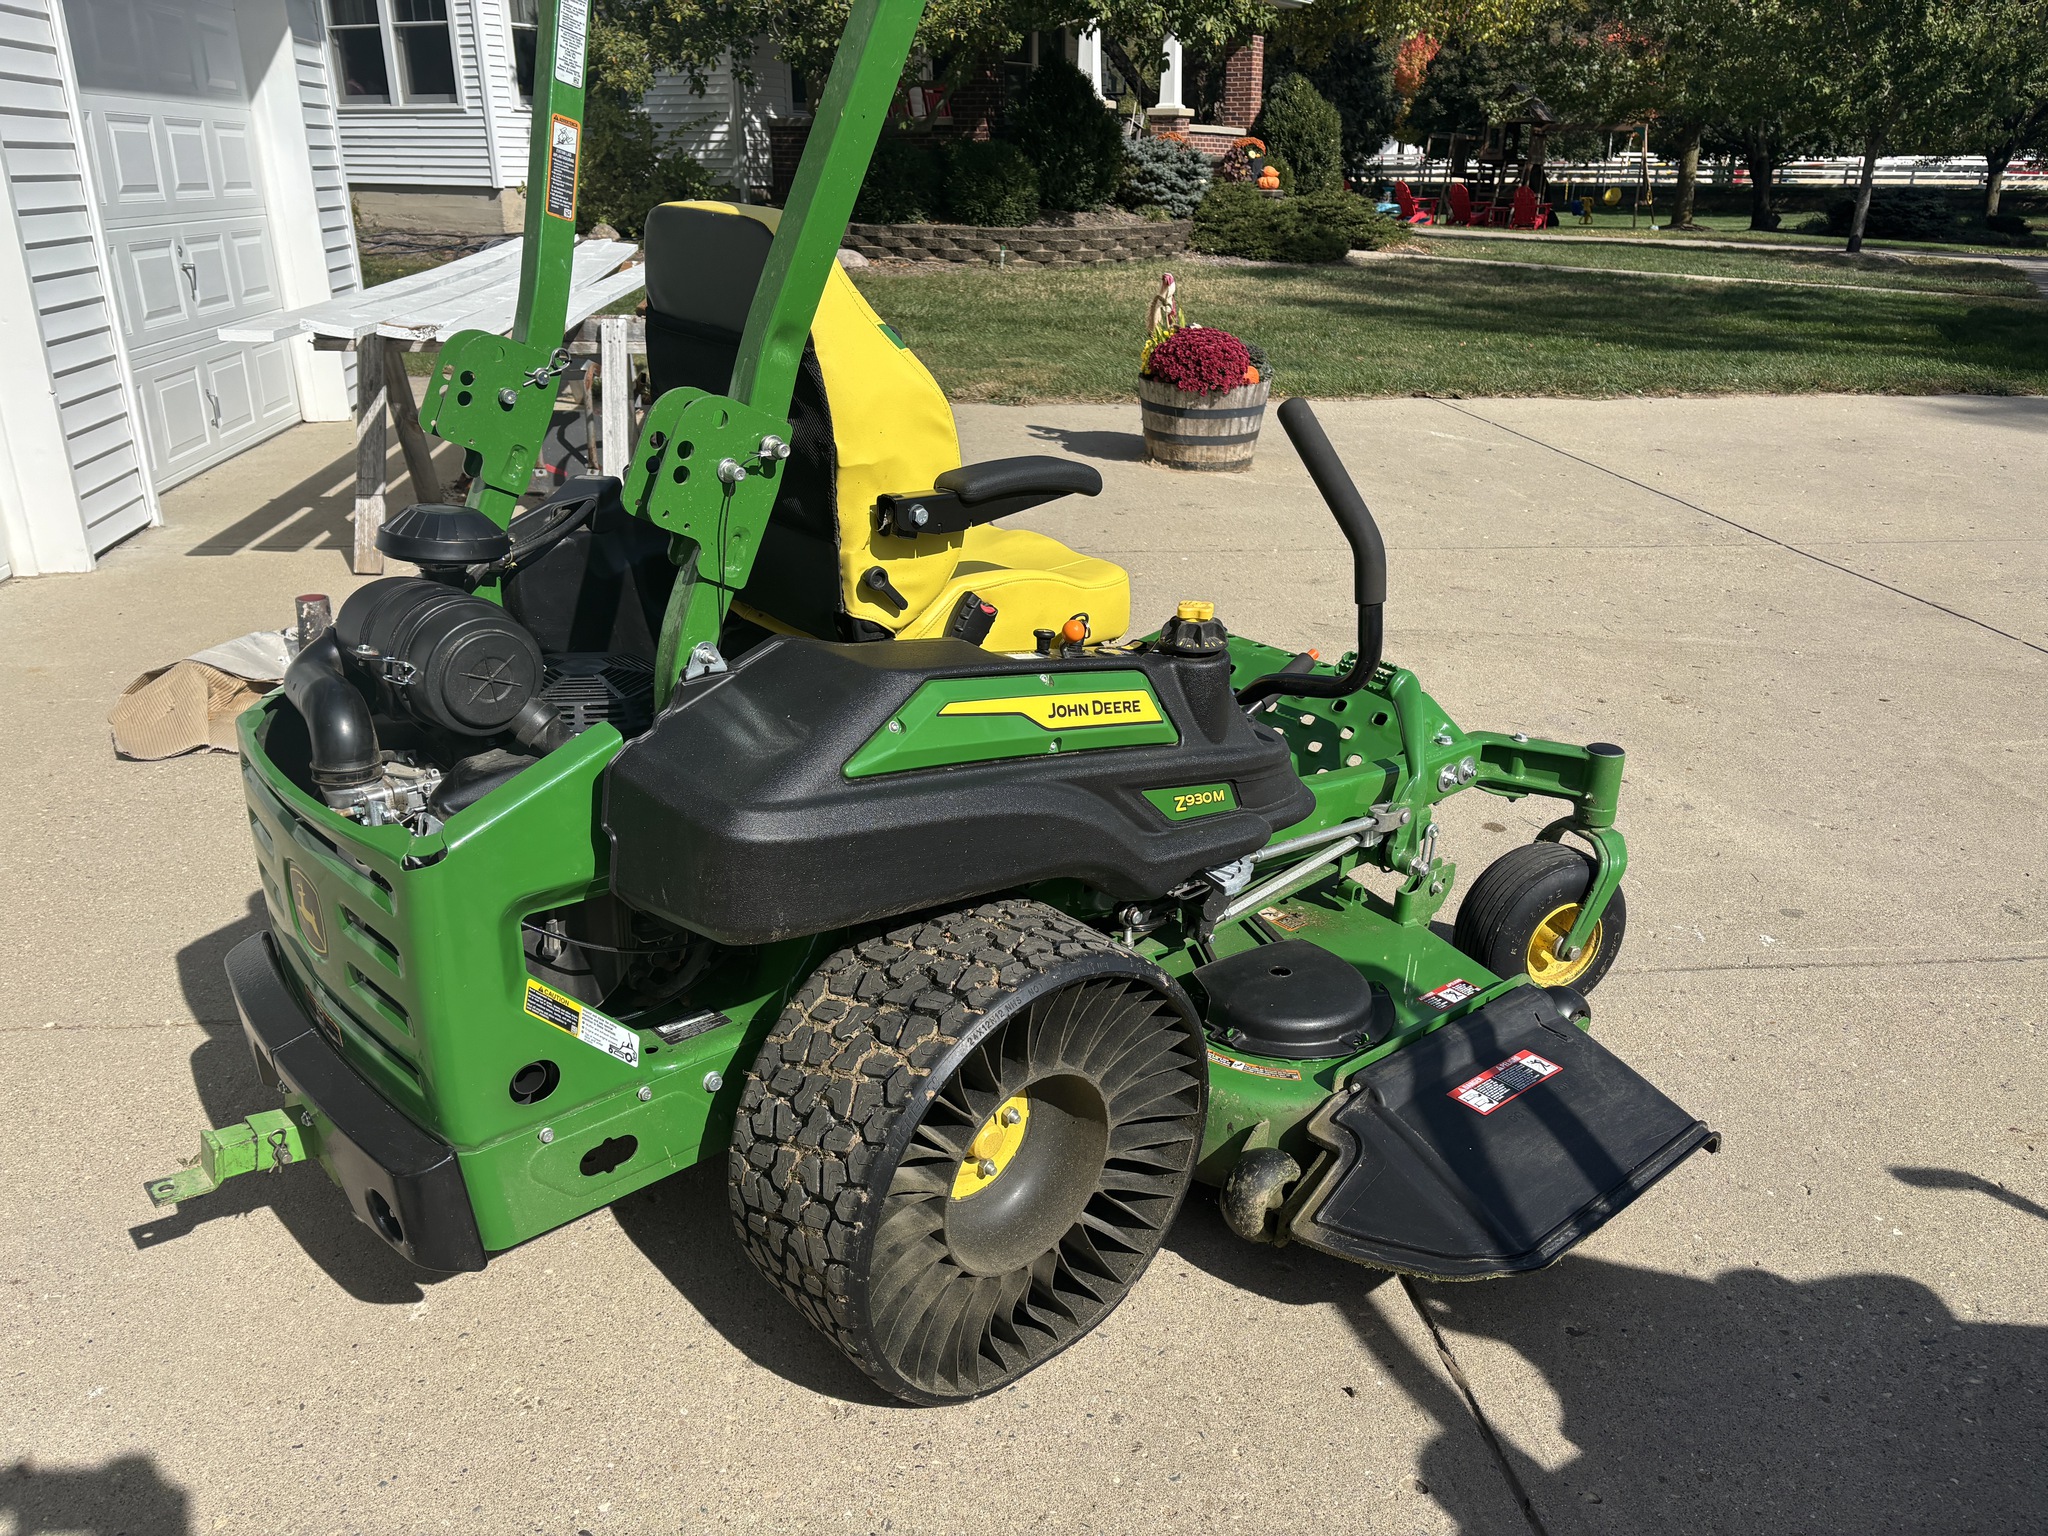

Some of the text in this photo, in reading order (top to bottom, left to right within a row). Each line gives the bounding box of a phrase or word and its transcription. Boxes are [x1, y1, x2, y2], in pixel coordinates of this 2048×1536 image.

[1048, 700, 1141, 719] JOHN DEERE
[1174, 789, 1225, 812] Z930M
[543, 989, 569, 1006] CAUTION
[1005, 997, 1022, 1017] NHS
